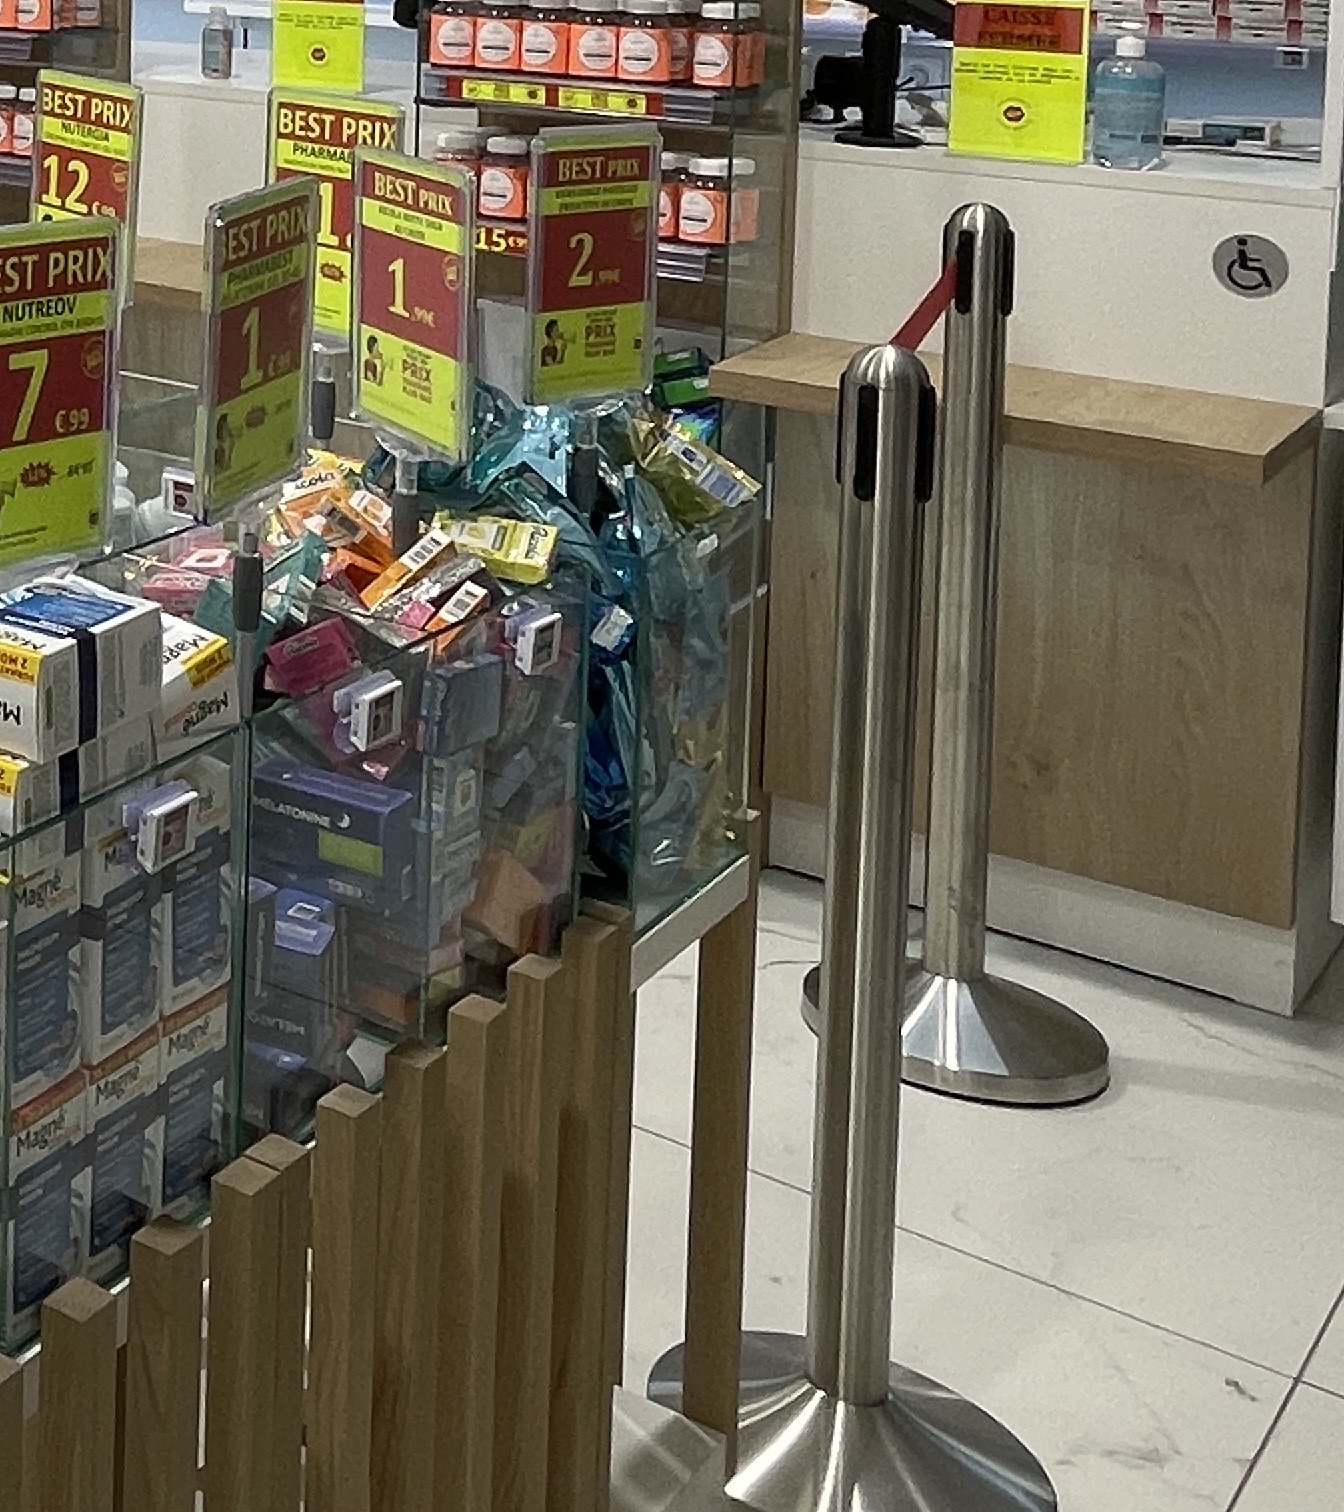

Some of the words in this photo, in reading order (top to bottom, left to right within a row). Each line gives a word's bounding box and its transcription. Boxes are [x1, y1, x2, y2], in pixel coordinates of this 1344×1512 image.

[42, 87, 87, 119] BEST
[91, 98, 131, 129] PRIX
[278, 108, 336, 140] BEST
[342, 117, 397, 151] PRIX
[42, 154, 90, 215] 12
[558, 156, 605, 182] BEST
[607, 158, 641, 179] PRIX
[316, 182, 340, 246] 1
[373, 171, 416, 206] BEST
[418, 188, 453, 216] PRIX
[224, 218, 261, 264] EST
[265, 204, 311, 248] PRIX
[475, 228, 507, 252] 15
[47, 245, 110, 288] PRIX
[567, 232, 595, 288] 2
[2, 295, 78, 325] NUTREOV
[388, 258, 411, 318] 1
[240, 306, 264, 390] 1
[8, 348, 50, 443] 7
[54, 407, 91, 434] €99
[168, 1014, 210, 1057] Magné
[15, 1110, 65, 1157] Magné
